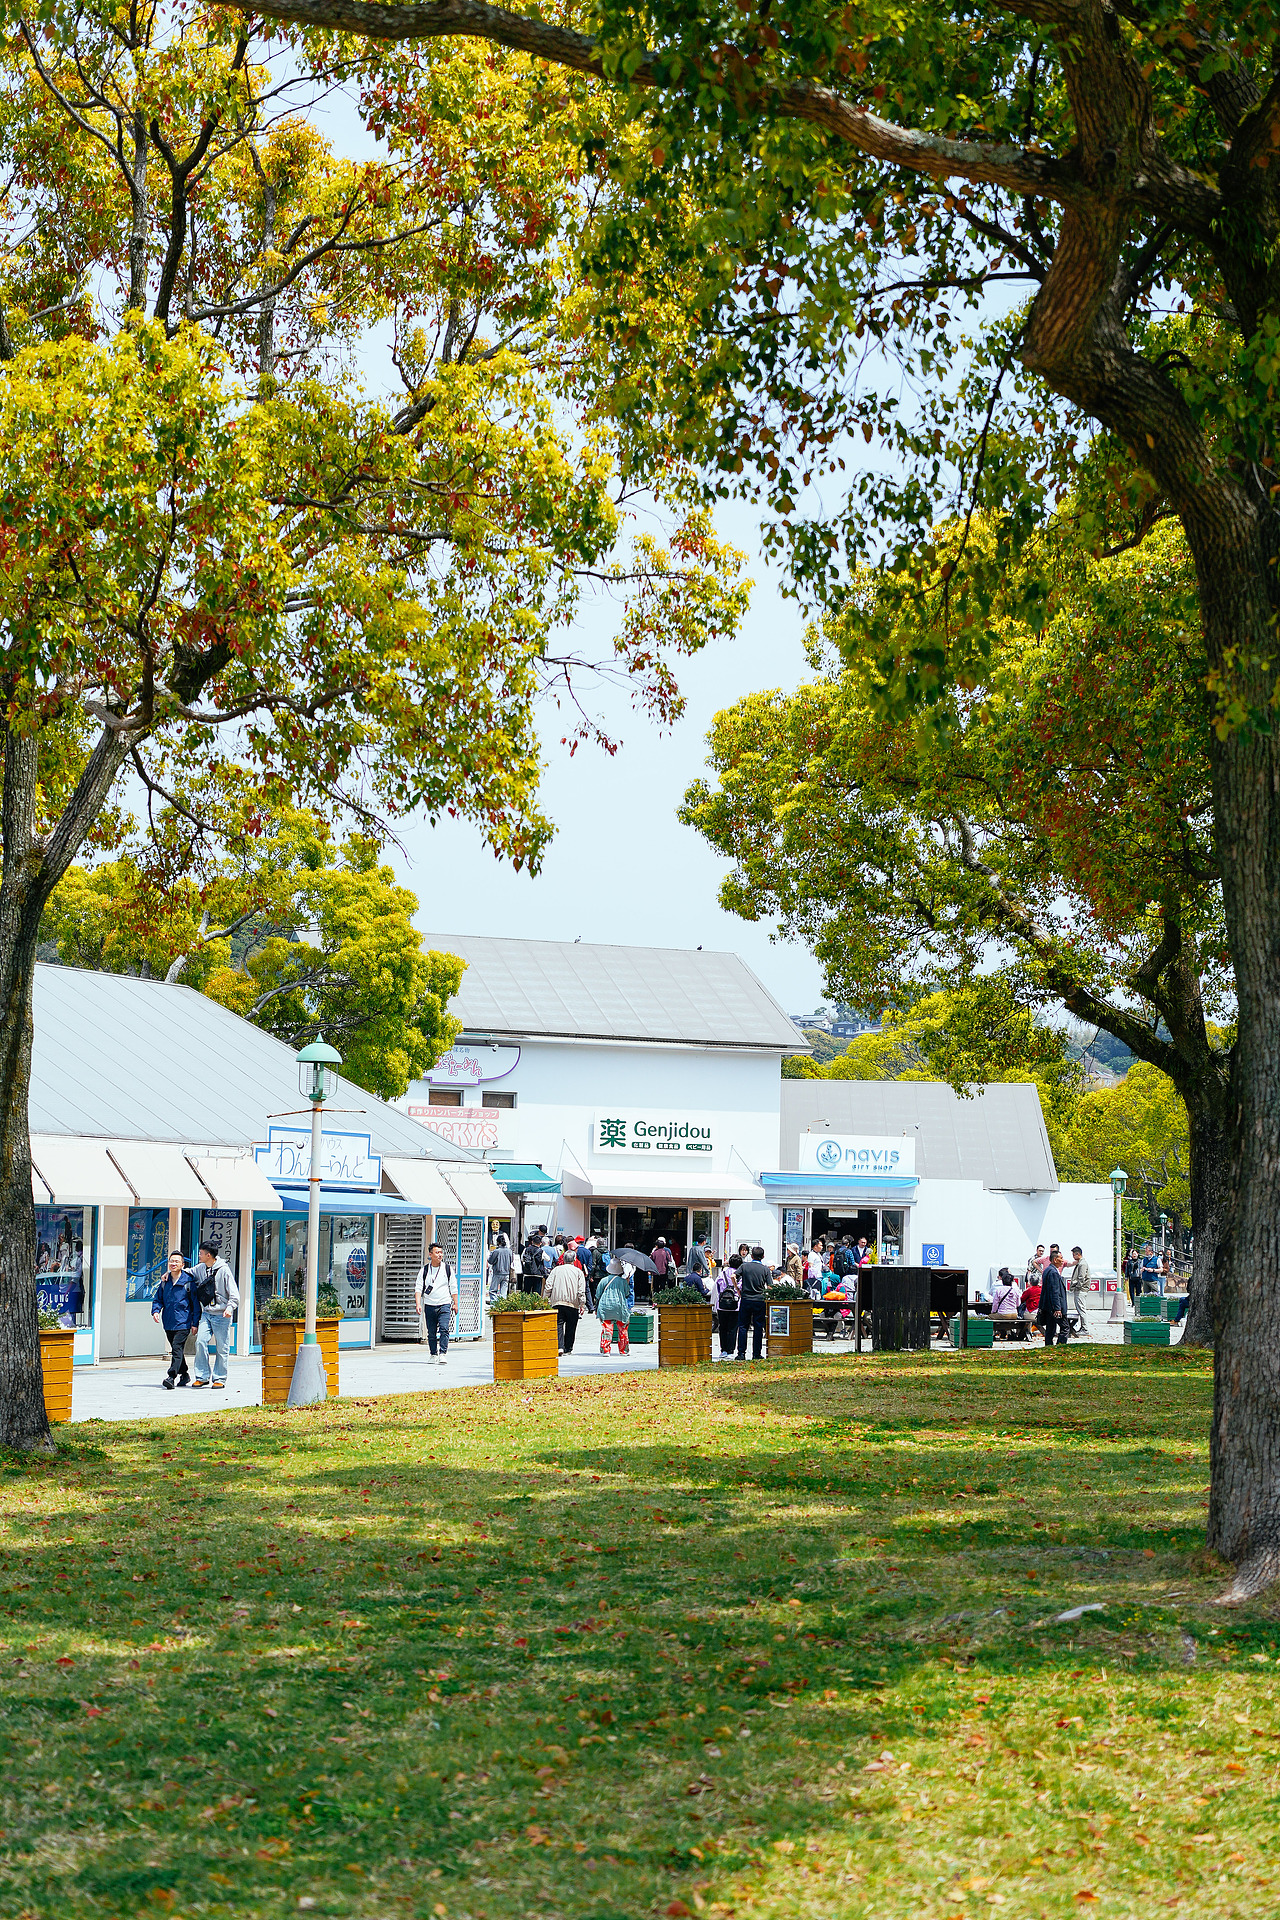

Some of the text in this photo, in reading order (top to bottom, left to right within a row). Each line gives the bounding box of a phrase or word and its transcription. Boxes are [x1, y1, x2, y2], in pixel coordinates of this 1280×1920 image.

[410, 1107, 497, 1118] 手作りハンバーガーショップ
[600, 1118, 626, 1147] 薬
[634, 1121, 710, 1141] Genjidou
[845, 1148, 899, 1163] navis
[49, 1293, 69, 1303] LUNG
[347, 1294, 365, 1309] PADI
